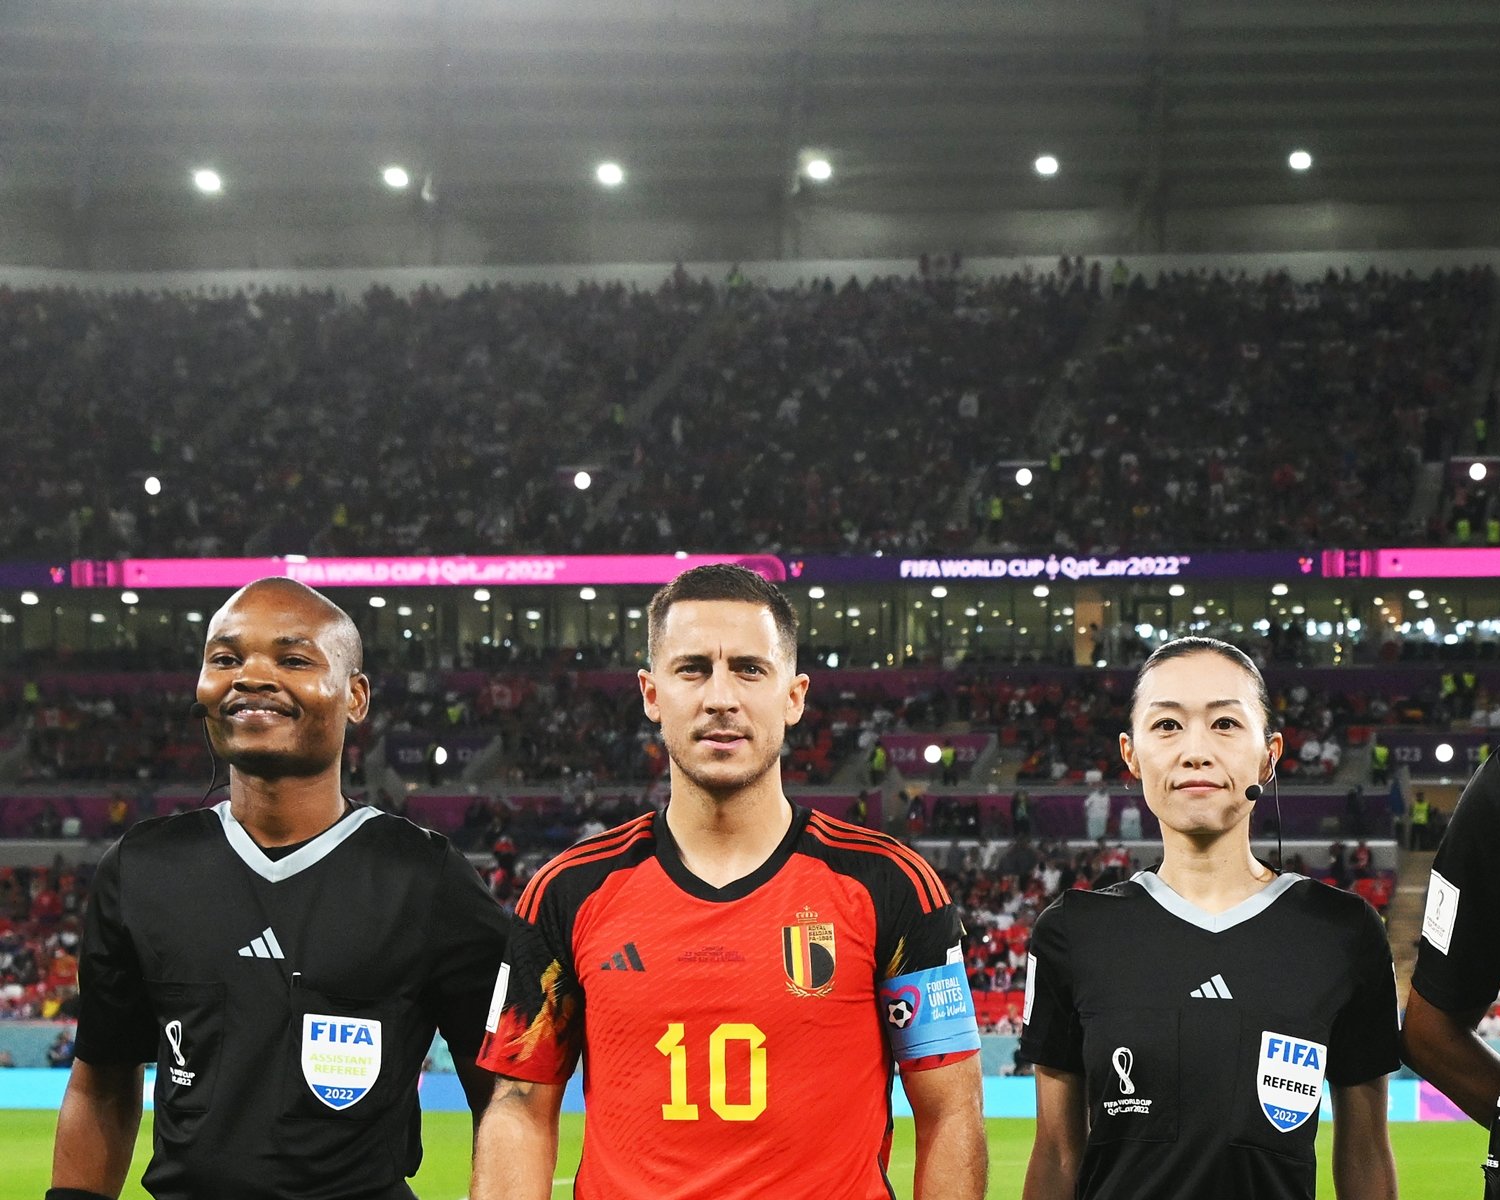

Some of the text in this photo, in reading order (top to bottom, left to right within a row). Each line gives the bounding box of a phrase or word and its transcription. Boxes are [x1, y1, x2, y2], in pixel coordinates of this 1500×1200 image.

[900, 559, 940, 578] FIFA
[941, 558, 1007, 578] WORLD
[1008, 558, 1045, 577] CUP
[926, 976, 960, 993] FOOTBALL
[928, 987, 963, 1007] UNITES
[931, 1002, 967, 1020] the World
[311, 1021, 374, 1046] FIFA
[309, 1053, 373, 1065] ASSISTANT
[1267, 1038, 1319, 1070] FIFA
[313, 1063, 368, 1077] REFEREE
[655, 1023, 767, 1121] 10
[324, 1088, 354, 1100] 2022
[1263, 1075, 1317, 1097] REFEREE
[1272, 1108, 1298, 1123] 2022
